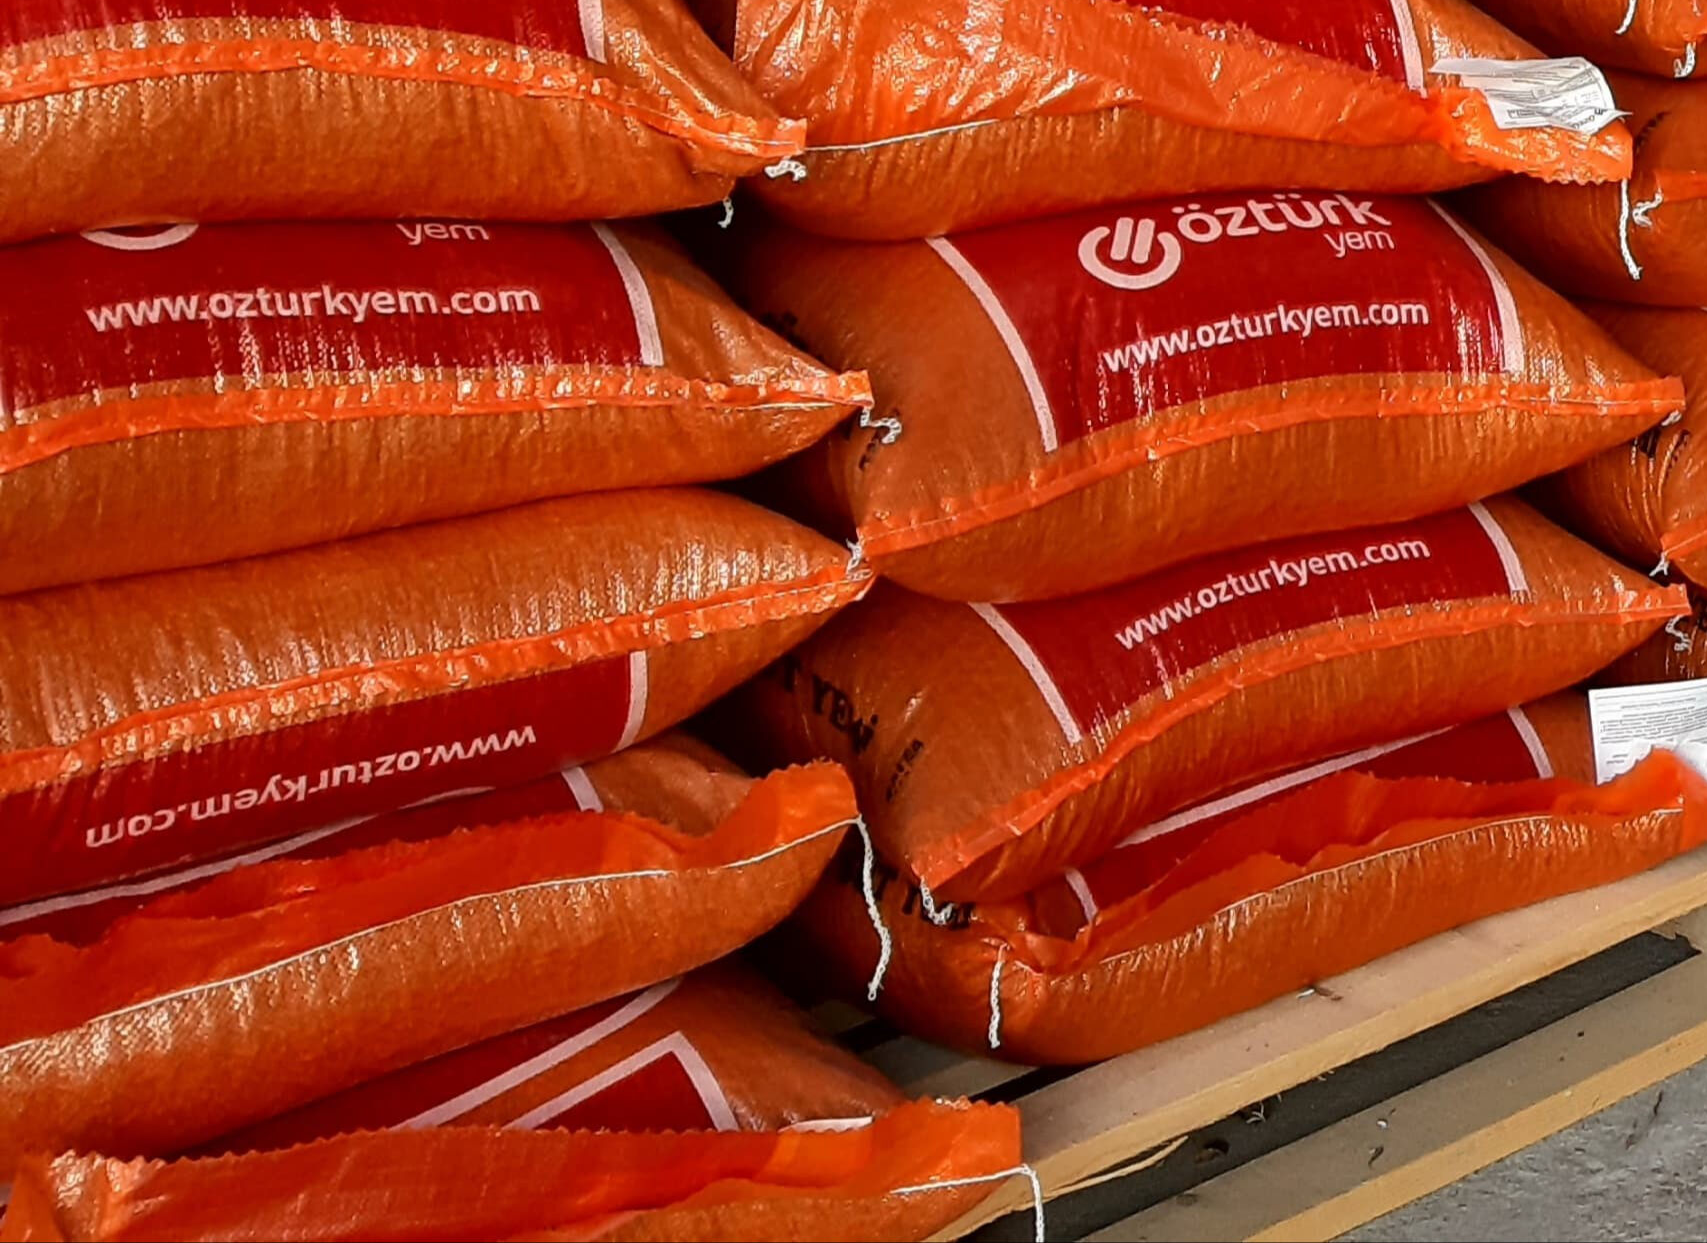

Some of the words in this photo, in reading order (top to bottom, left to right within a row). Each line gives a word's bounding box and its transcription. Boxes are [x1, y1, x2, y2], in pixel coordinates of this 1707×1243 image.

[1178, 192, 1393, 244] öztürk
[1323, 227, 1396, 258] yem
[86, 283, 543, 333] www.ozturkyem.com
[1101, 297, 1429, 374] www.ozturkyem.com
[1115, 534, 1431, 651] www.ozturkyem.com
[84, 720, 538, 850] www.ozturkyem.com
